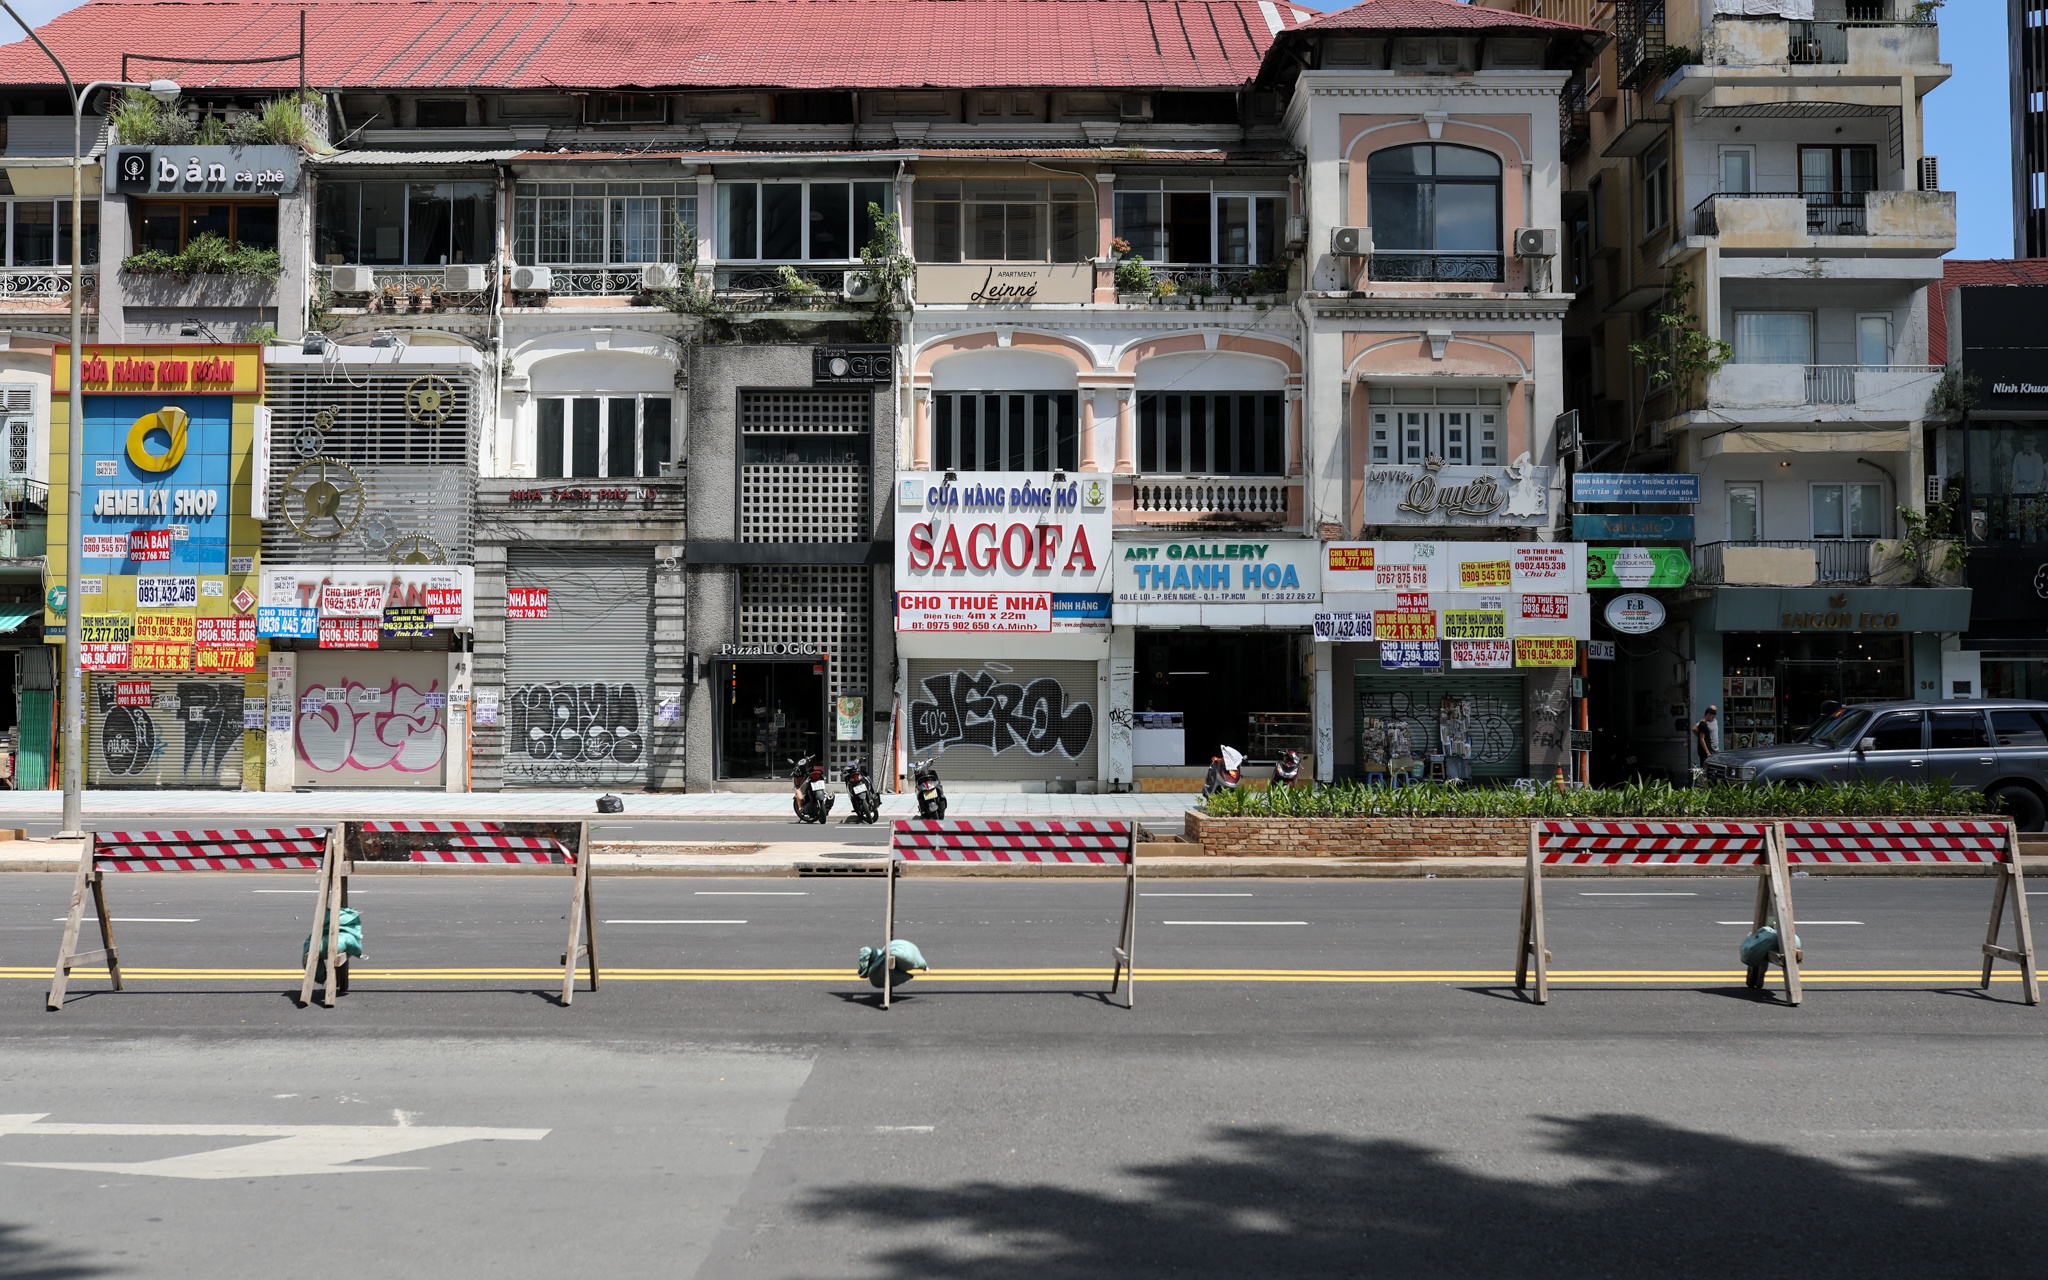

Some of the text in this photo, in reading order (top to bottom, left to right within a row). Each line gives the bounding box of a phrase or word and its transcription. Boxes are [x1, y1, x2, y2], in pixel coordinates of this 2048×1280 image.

[159, 156, 285, 187] bản cà phê
[81, 351, 109, 383] CỬA
[114, 356, 155, 383] HÀNG
[160, 361, 188, 383] KIM
[1993, 382, 2018, 393] Ninh
[928, 479, 1078, 508] CỬA HÀNG ĐỒNG HỒ
[94, 489, 218, 516] JEWELRY SHOP
[84, 543, 128, 552] 0909 545 670
[131, 535, 149, 550] NHÀ
[151, 534, 169, 550] BÁN
[909, 522, 1097, 571] SAGOFA
[131, 552, 146, 560] 0932
[146, 551, 157, 560] 768
[158, 551, 170, 560] 782
[1125, 545, 1270, 559] ART GALLERY
[1330, 557, 1374, 567] 0908.777.488
[1515, 562, 1566, 570] 0902.445.338
[1133, 563, 1300, 588] THANH HOA
[1376, 572, 1427, 584] 0767 875 618
[1461, 569, 1511, 582] 0909 545 670
[139, 586, 196, 603] 0931.432.469
[428, 590, 461, 606] NHÀ BÁN
[509, 589, 547, 607] NHÀ BÁN
[1139, 592, 1151, 601] LỢI
[1203, 593, 1214, 601] Q.1
[1221, 593, 1246, 601] TP.HCM
[1397, 593, 1428, 606] NHÀ BÁN
[324, 597, 382, 610] 0925.45.47.47
[901, 593, 1048, 611] CHO THUÊ NHÀ
[1075, 600, 1099, 610] HÃNG
[1627, 599, 1644, 610] F&B
[428, 607, 441, 615] 0932
[441, 607, 452, 615] 768
[509, 609, 548, 618] 0932 768 782
[923, 612, 943, 621] Diện
[944, 612, 964, 620] Tích:
[967, 611, 986, 620] 4m
[1000, 611, 1026, 620] 22m
[1523, 604, 1568, 615] 0936 445 201
[196, 617, 256, 629] CHO THUÊ NHÀ
[259, 617, 316, 634] 0936 445 201
[320, 618, 379, 629] CHO THUÊ NHÀ
[926, 621, 950, 630] 0975
[952, 621, 970, 630] 902
[971, 621, 990, 630] 650
[1781, 612, 1900, 629] SAIGON ECO
[137, 625, 193, 638] 0919.04.38.38
[196, 629, 256, 642] 0906.905.006
[319, 629, 379, 642] 0906.905.006
[1315, 621, 1372, 637] 0931.432.469
[1376, 624, 1435, 639] 0922.16.36.36
[1445, 625, 1504, 638] 0972.377.039
[1381, 650, 1440, 662] 0907.594.883
[1453, 650, 1510, 661] 0925.45.47.47
[1516, 649, 1574, 660] 0919.04.38.38
[1589, 642, 1614, 657] GIỮ XE
[133, 655, 189, 669] 0922.16.36.36
[197, 651, 255, 668] 0908.777.488
[118, 682, 150, 695] NHÀ BÁN
[1920, 680, 1935, 690] 36
